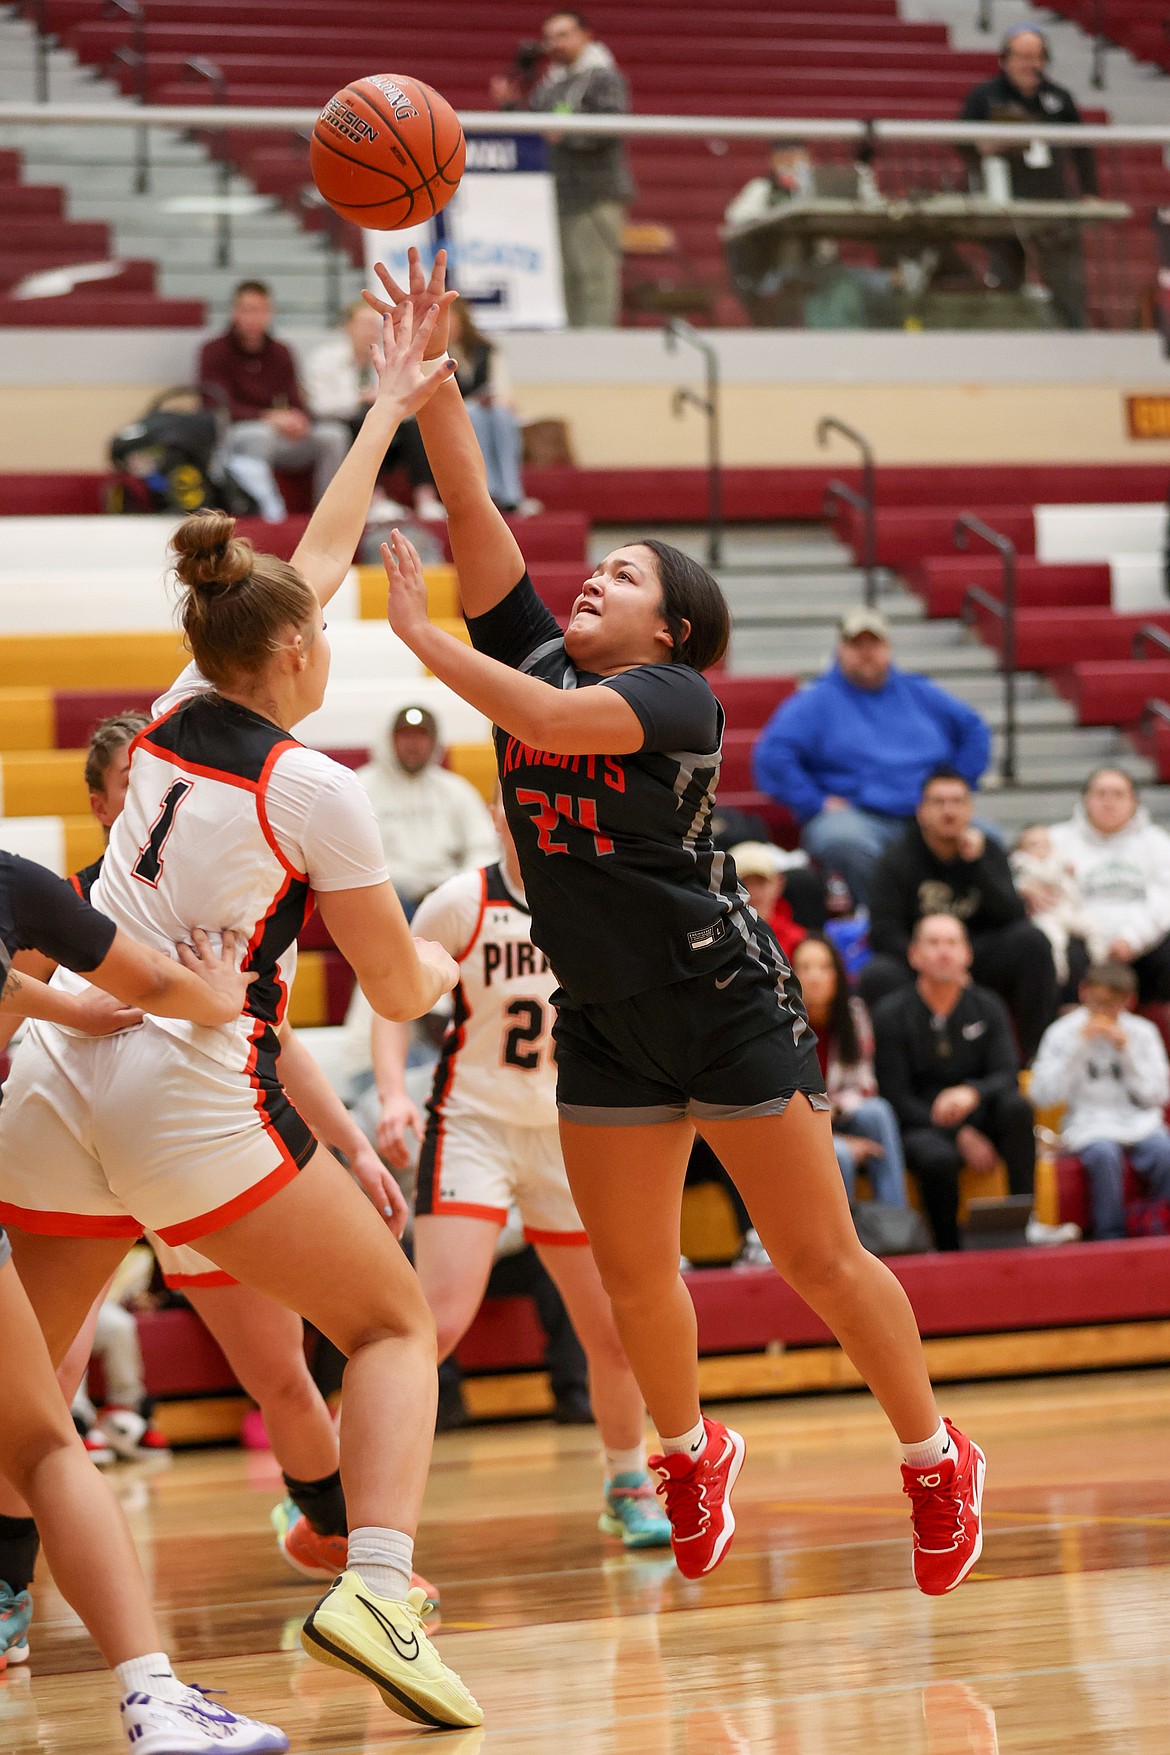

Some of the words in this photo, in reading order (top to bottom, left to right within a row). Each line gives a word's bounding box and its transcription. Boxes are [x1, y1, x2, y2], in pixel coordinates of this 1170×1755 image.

[324, 98, 380, 144] ECISION
[131, 777, 194, 890] 1
[515, 787, 615, 857] 24
[501, 994, 558, 1073] 2
